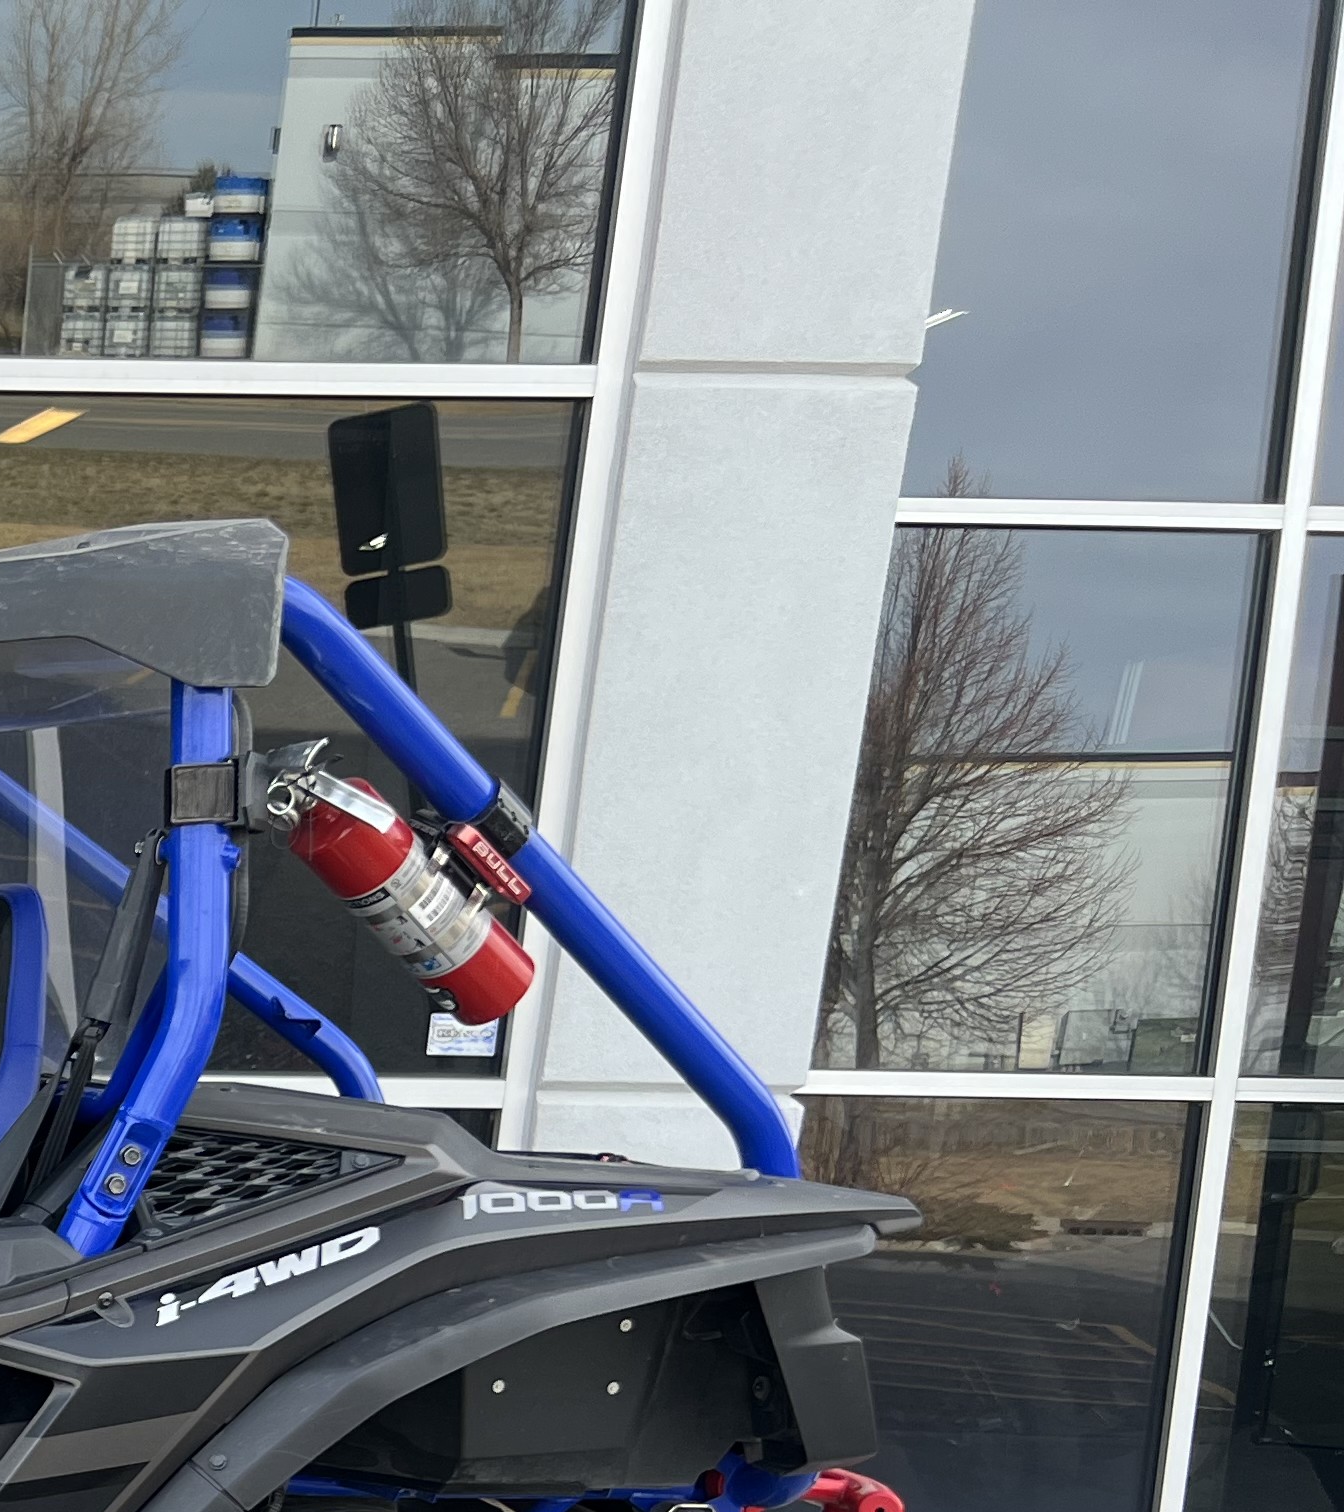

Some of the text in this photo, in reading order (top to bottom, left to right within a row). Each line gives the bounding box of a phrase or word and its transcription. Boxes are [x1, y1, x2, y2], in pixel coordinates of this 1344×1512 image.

[472, 841, 522, 896] BULL
[460, 1188, 665, 1221] 1000R
[156, 1226, 382, 1328] i-4WD
